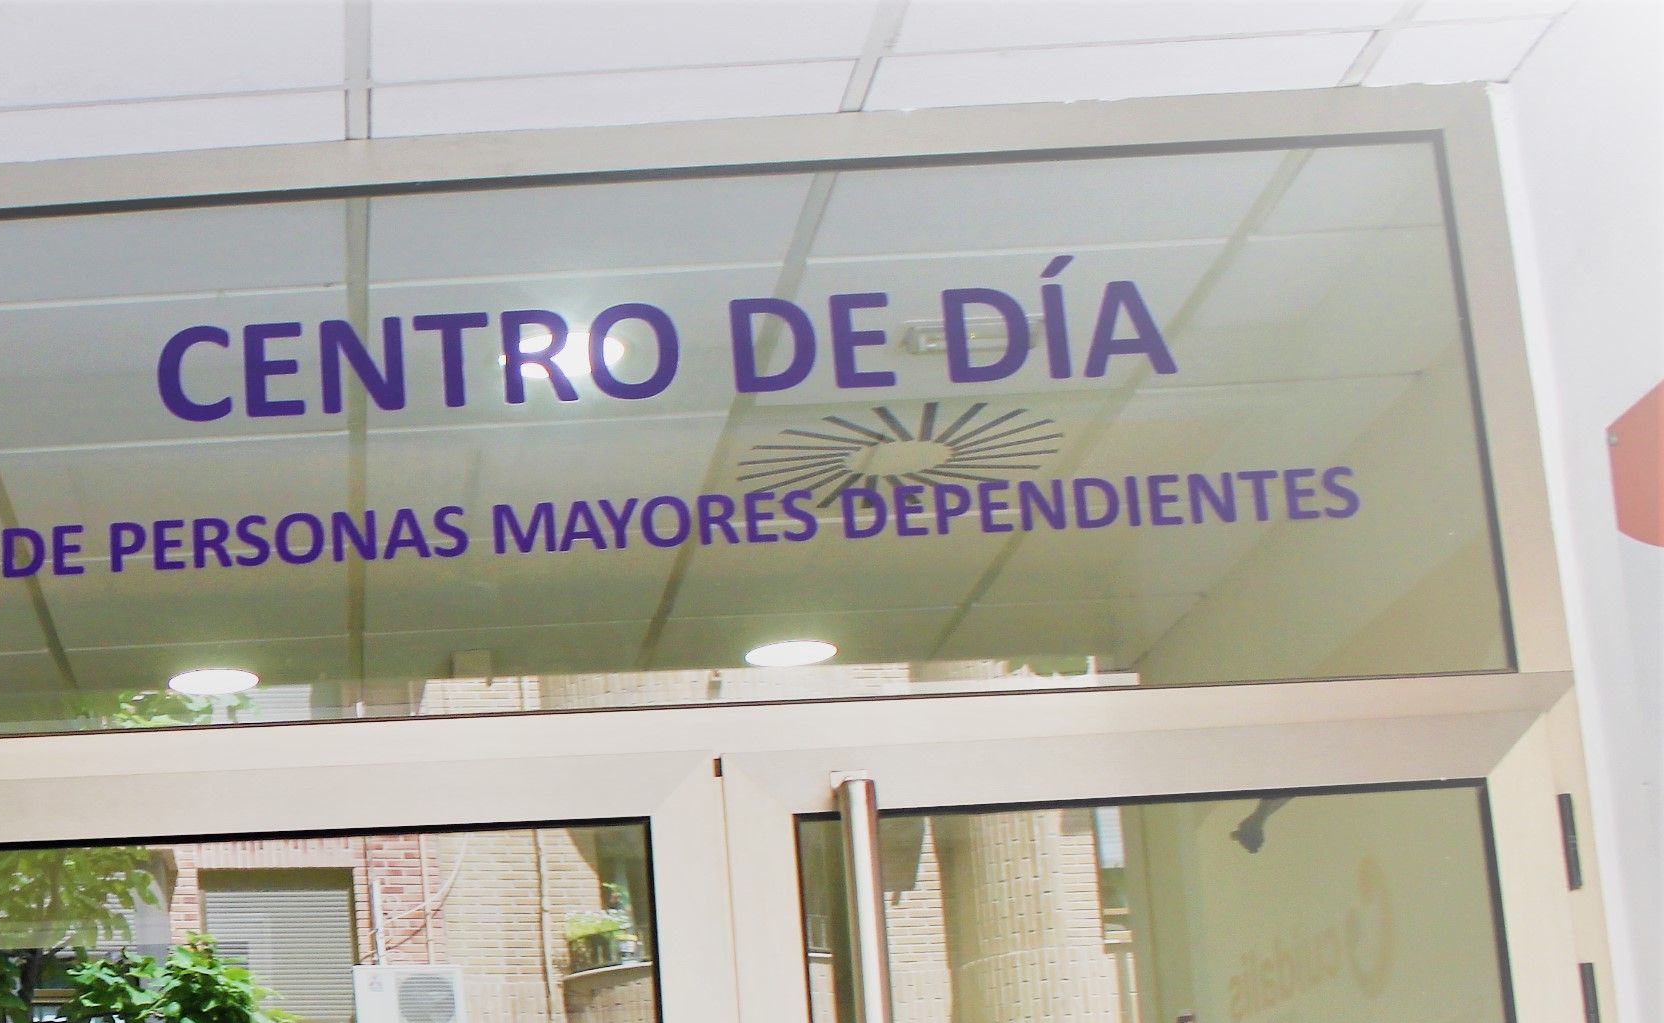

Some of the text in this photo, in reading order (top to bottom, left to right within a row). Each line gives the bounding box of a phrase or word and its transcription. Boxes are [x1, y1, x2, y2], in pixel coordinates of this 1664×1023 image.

[157, 256, 1178, 423] CENTRO DE DÍA
[2, 468, 1360, 579] DE PERSONAS MAYORES DEPENDIENTES
